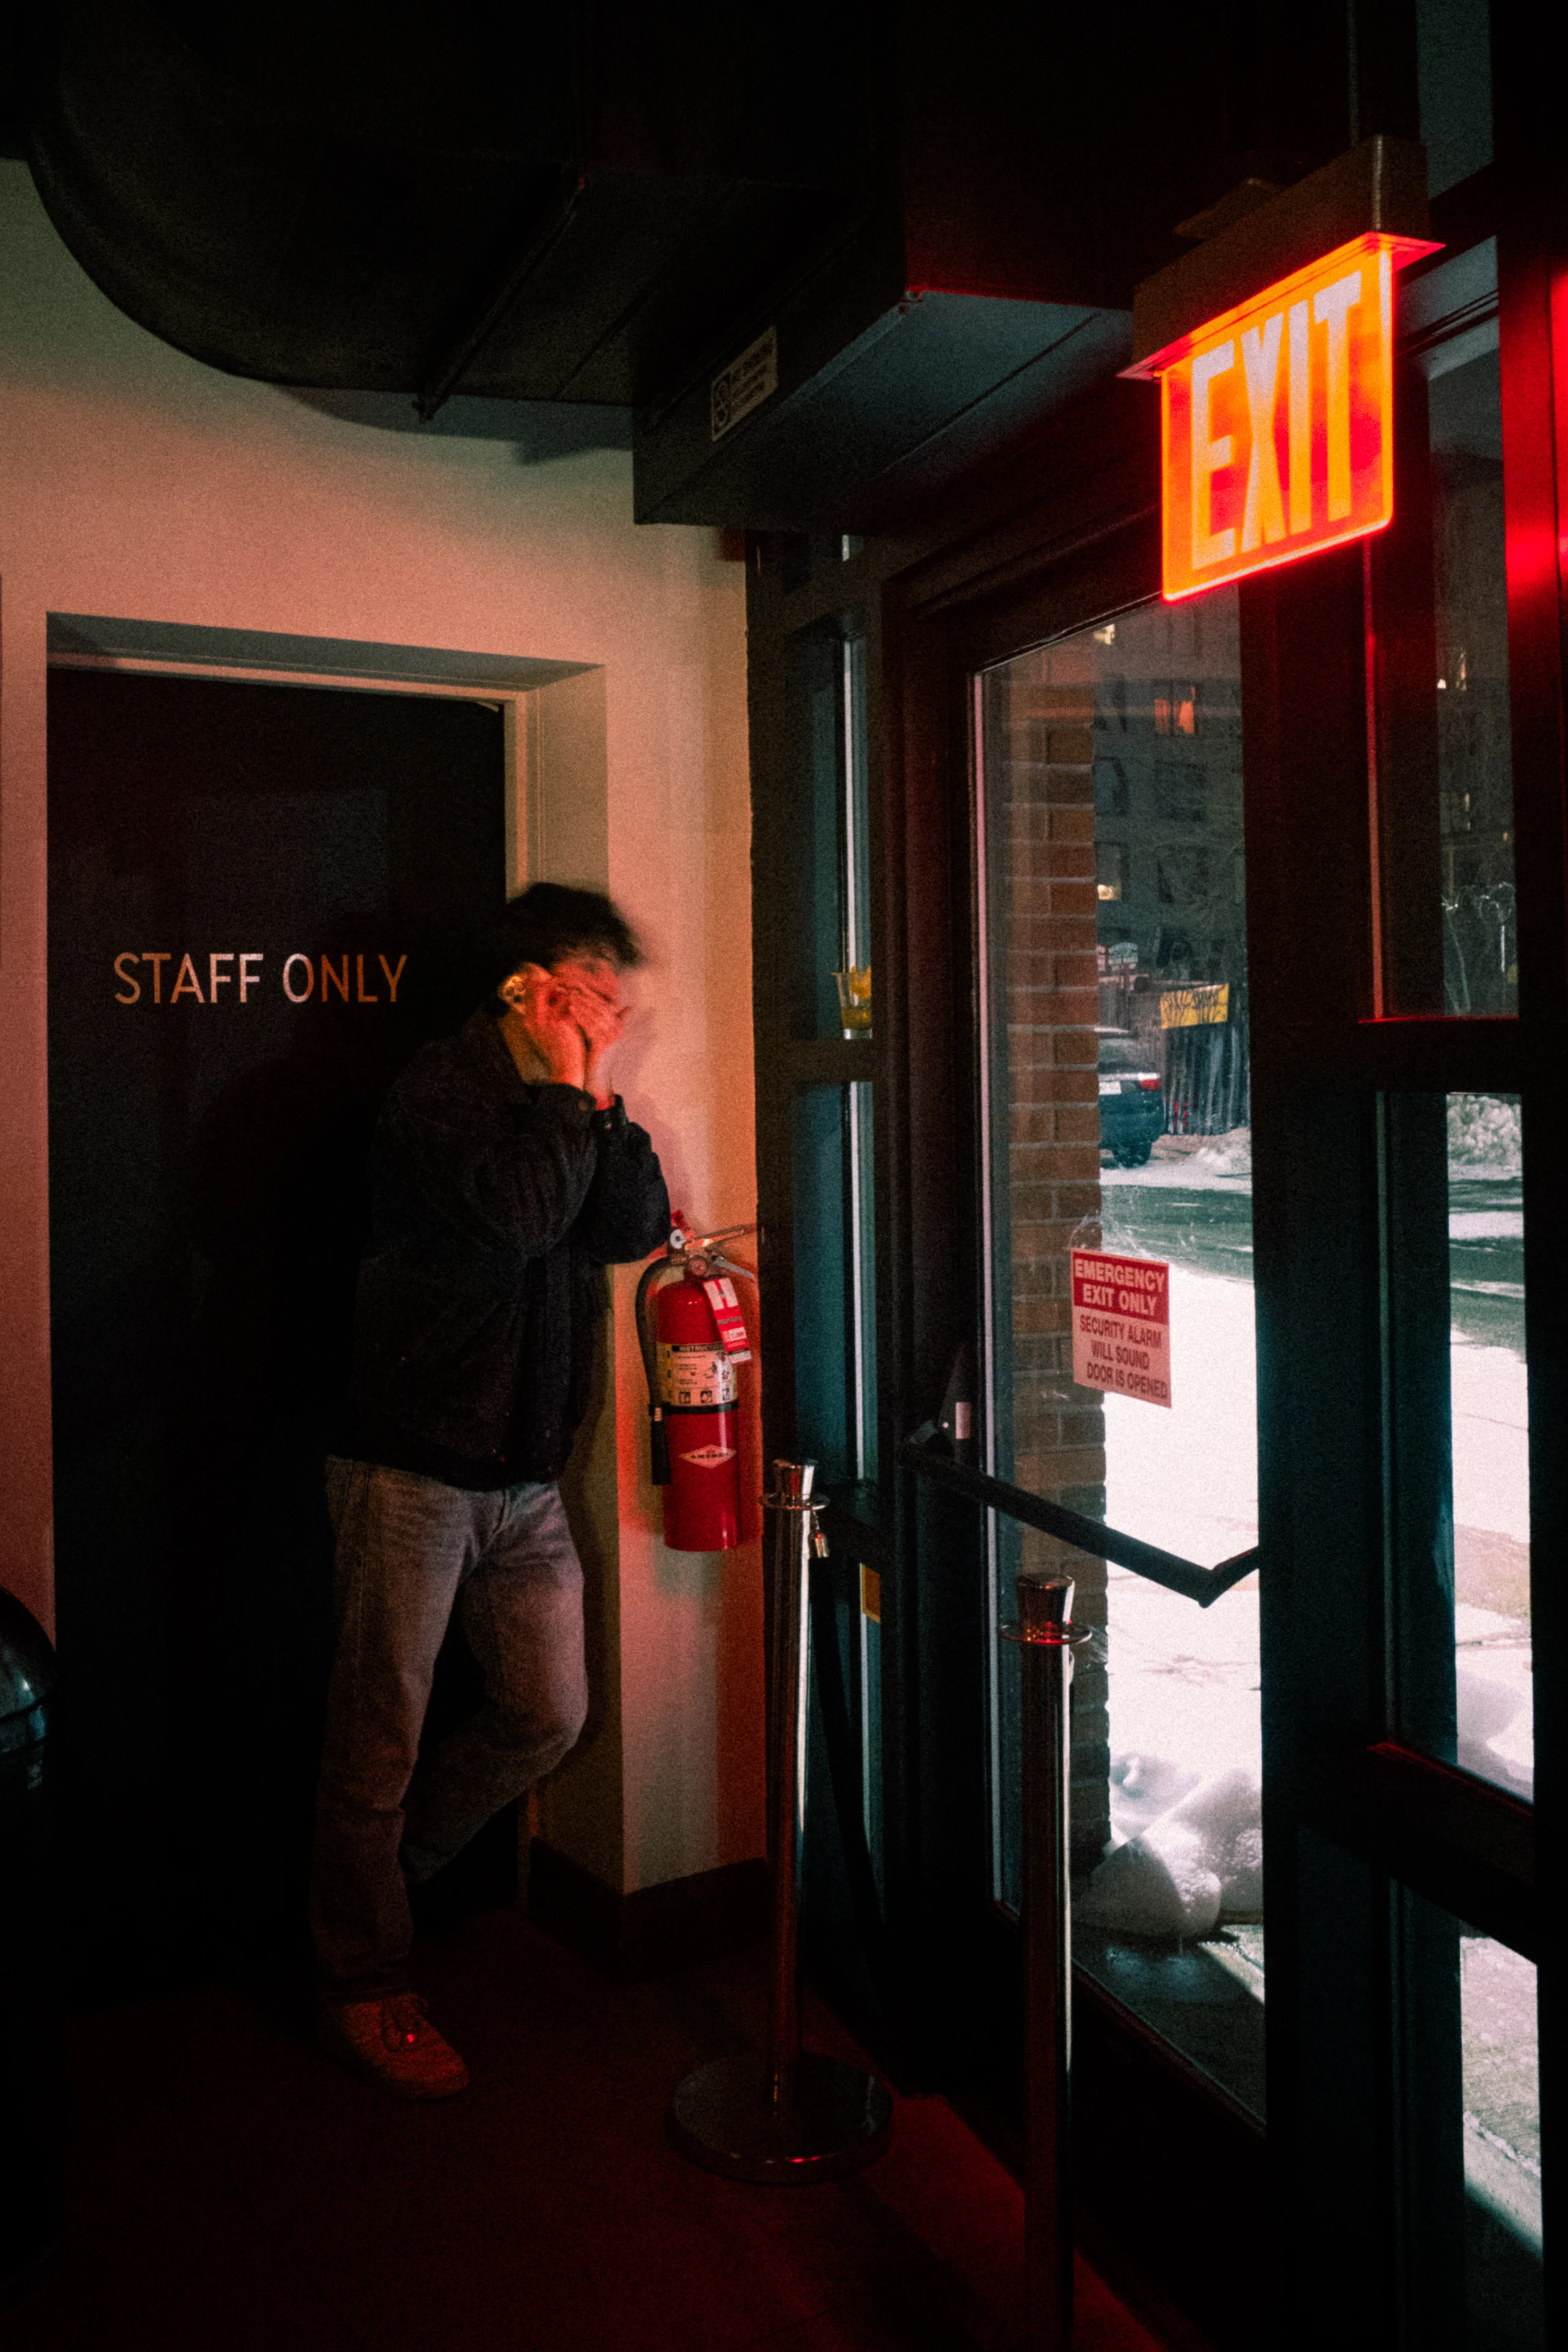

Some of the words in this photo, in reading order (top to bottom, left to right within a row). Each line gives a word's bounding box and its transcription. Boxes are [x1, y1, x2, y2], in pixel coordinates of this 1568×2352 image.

[1191, 270, 1362, 570] EXIT
[114, 952, 264, 1005] STAFF
[282, 953, 408, 1003] ONLY
[1075, 1259, 1164, 1292] EMERGENCY
[1083, 1283, 1115, 1308] EXIT
[1118, 1291, 1157, 1316] ONLY
[1080, 1314, 1125, 1340] SECURITY
[1128, 1325, 1161, 1349] ALARM
[1091, 1340, 1114, 1361] WILL
[1116, 1346, 1150, 1370] SOUND
[1087, 1362, 1113, 1384] DOOR
[1115, 1369, 1125, 1387] IS
[1127, 1373, 1167, 1398] OPENED
